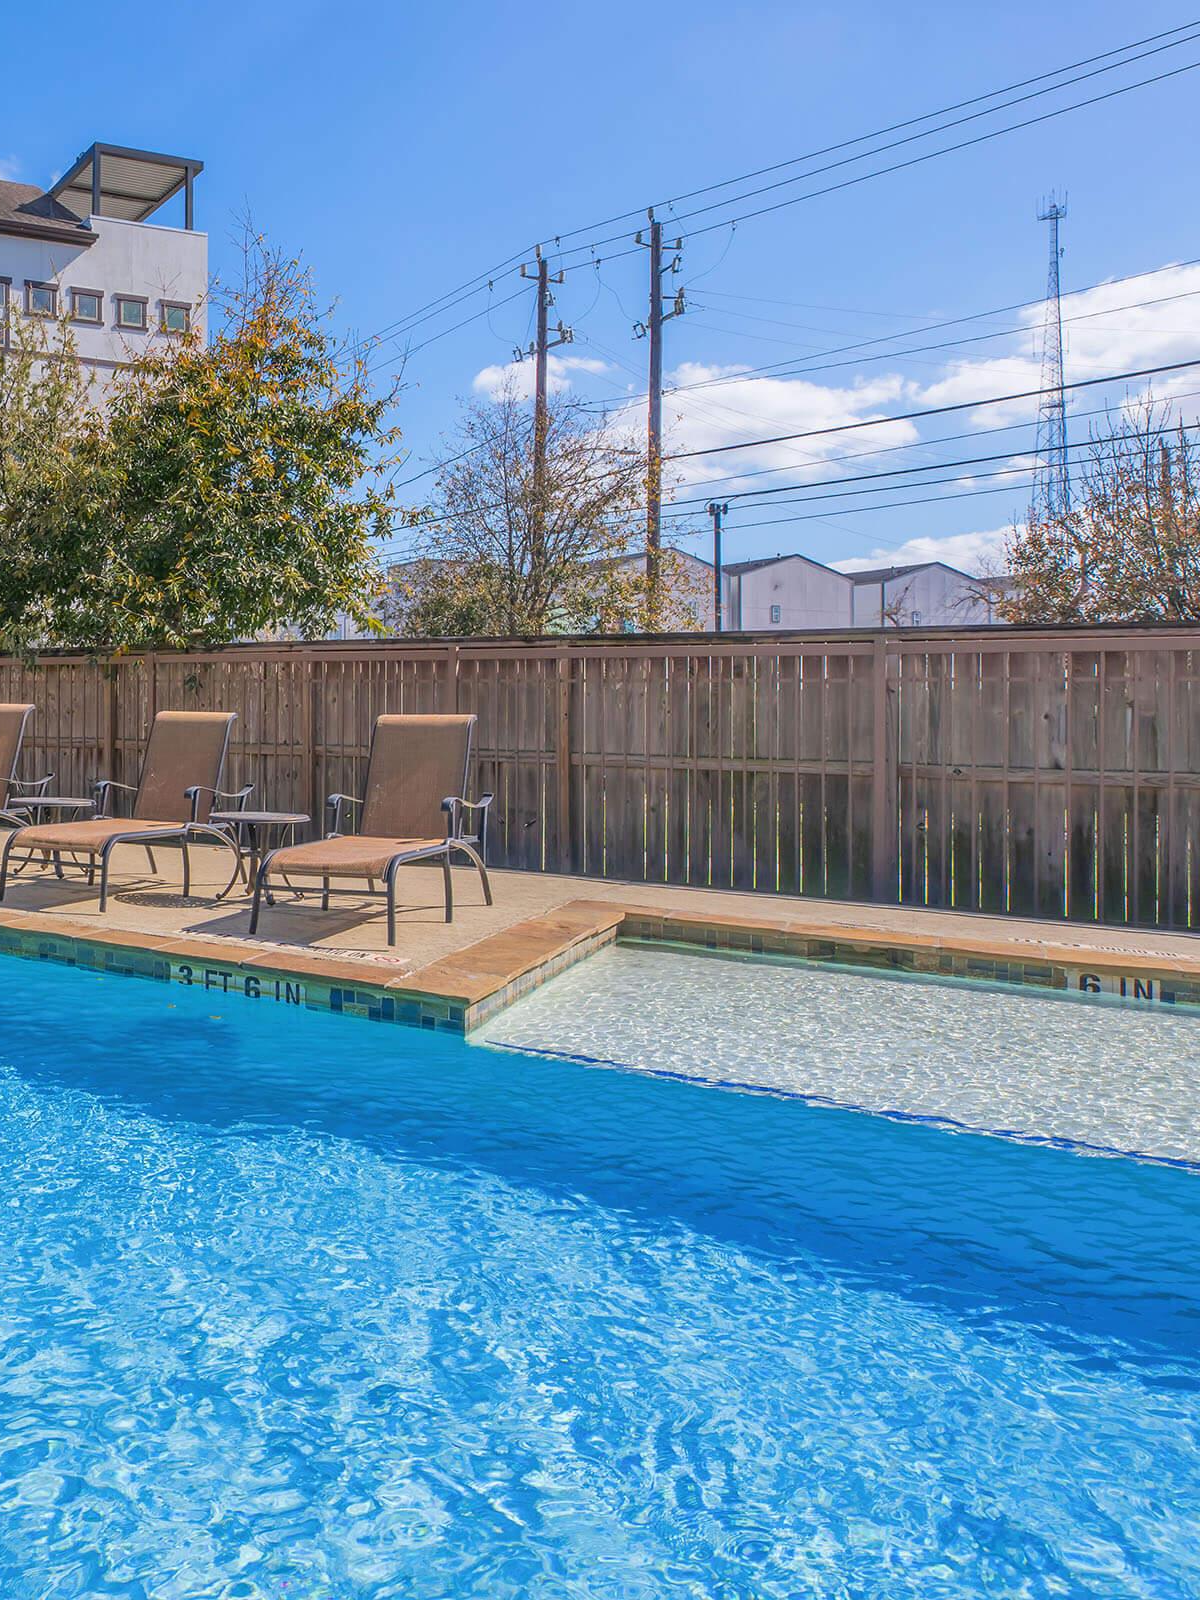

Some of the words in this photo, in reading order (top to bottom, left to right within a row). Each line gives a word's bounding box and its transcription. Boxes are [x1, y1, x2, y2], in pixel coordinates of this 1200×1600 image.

[179, 965, 193, 986] 3
[205, 969, 232, 993] FT
[245, 976, 261, 999] 6
[275, 980, 300, 1006] IN
[1079, 973, 1101, 993] 6
[1119, 976, 1153, 1000] IN
